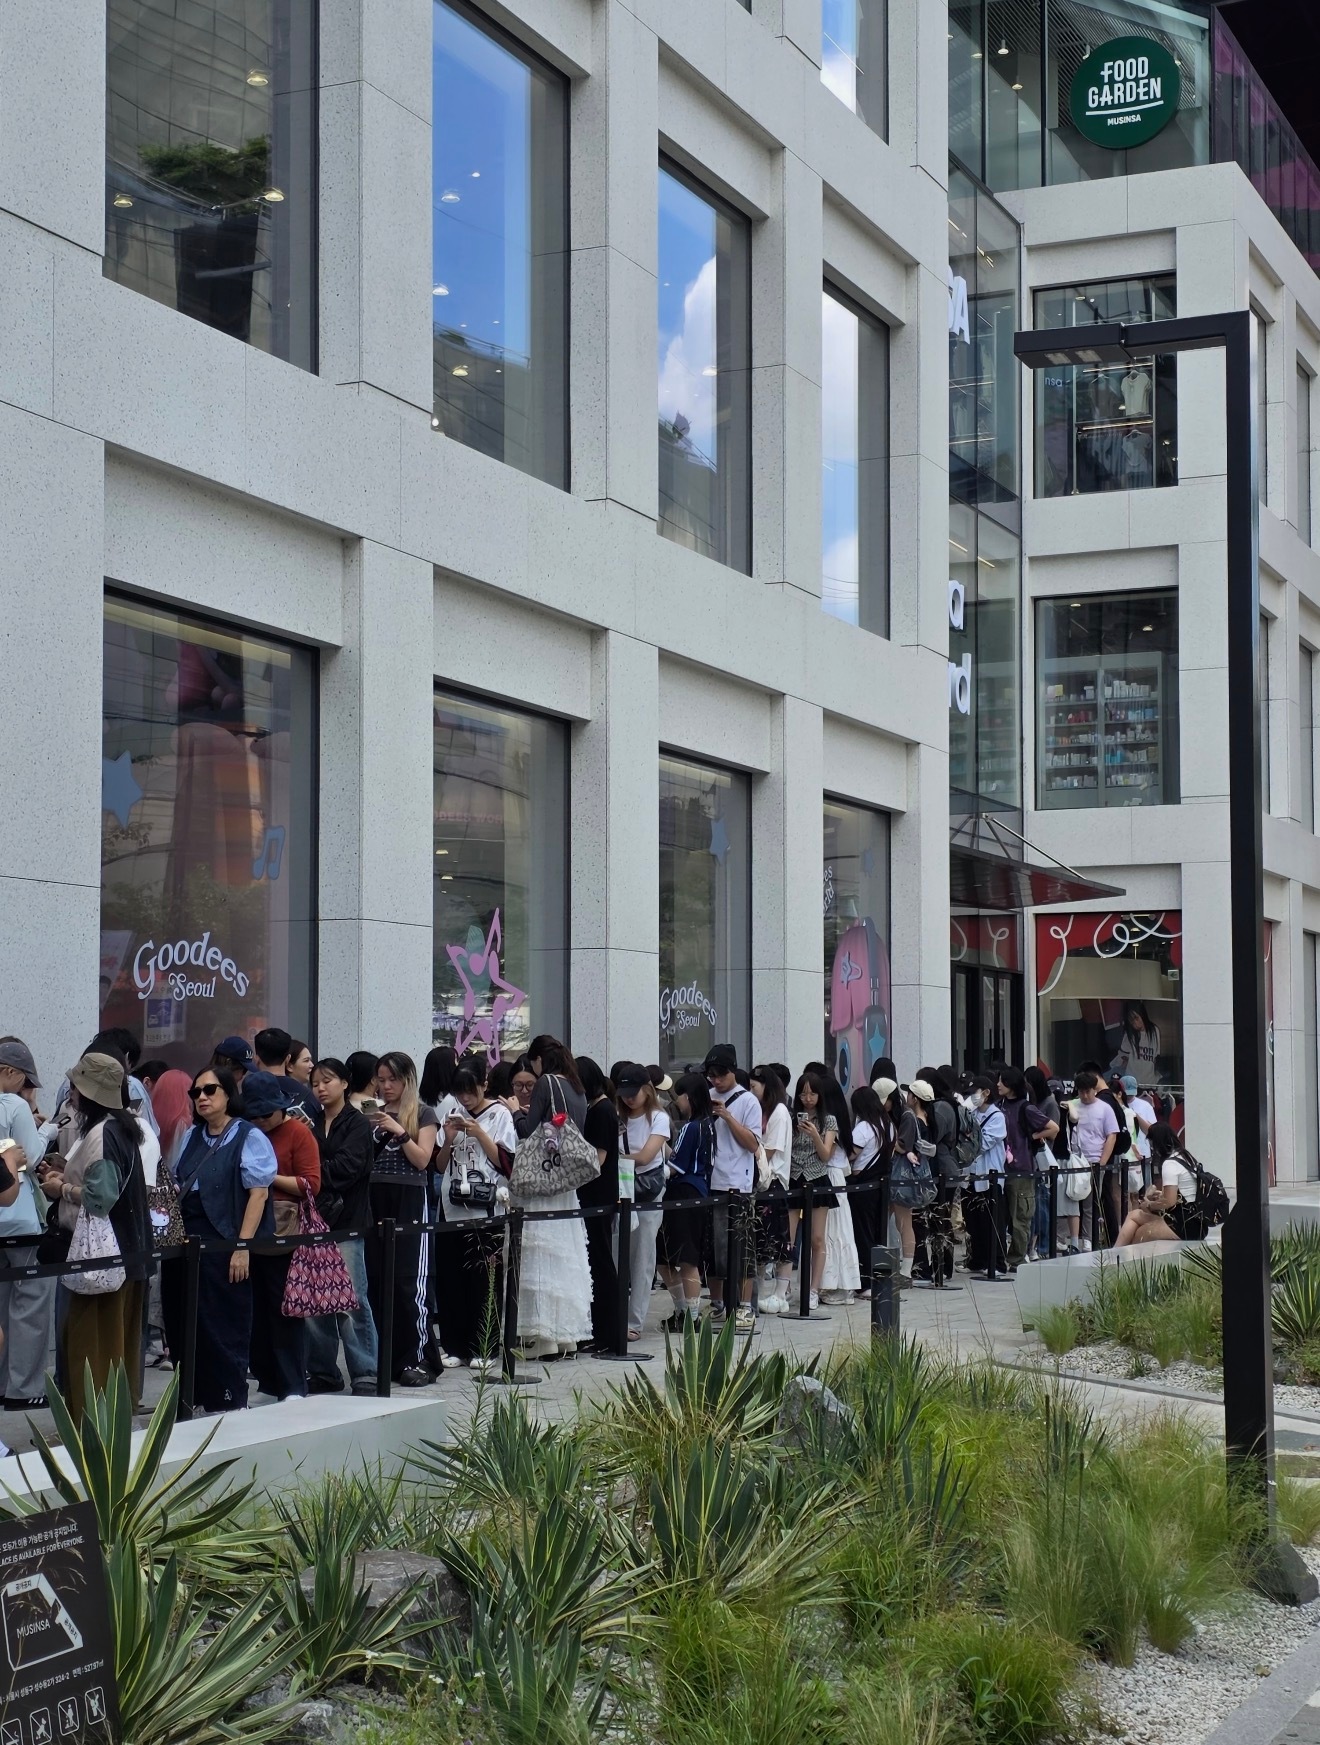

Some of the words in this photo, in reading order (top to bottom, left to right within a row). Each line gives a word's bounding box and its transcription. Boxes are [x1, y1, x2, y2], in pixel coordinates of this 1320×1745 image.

[1100, 56, 1149, 83] FOOD
[1088, 77, 1161, 108] GARDEN
[1107, 114, 1141, 126] MUSINSA
[133, 931, 250, 1000] Goodees
[168, 973, 216, 1001] Seoul
[660, 980, 718, 1030] Goodees
[676, 1010, 701, 1030] Seoul
[13, 1554, 19, 1563] IS
[19, 1546, 46, 1561] AVAILABLE
[46, 1543, 57, 1554] FOR
[16, 1618, 51, 1639] MUSINSA
